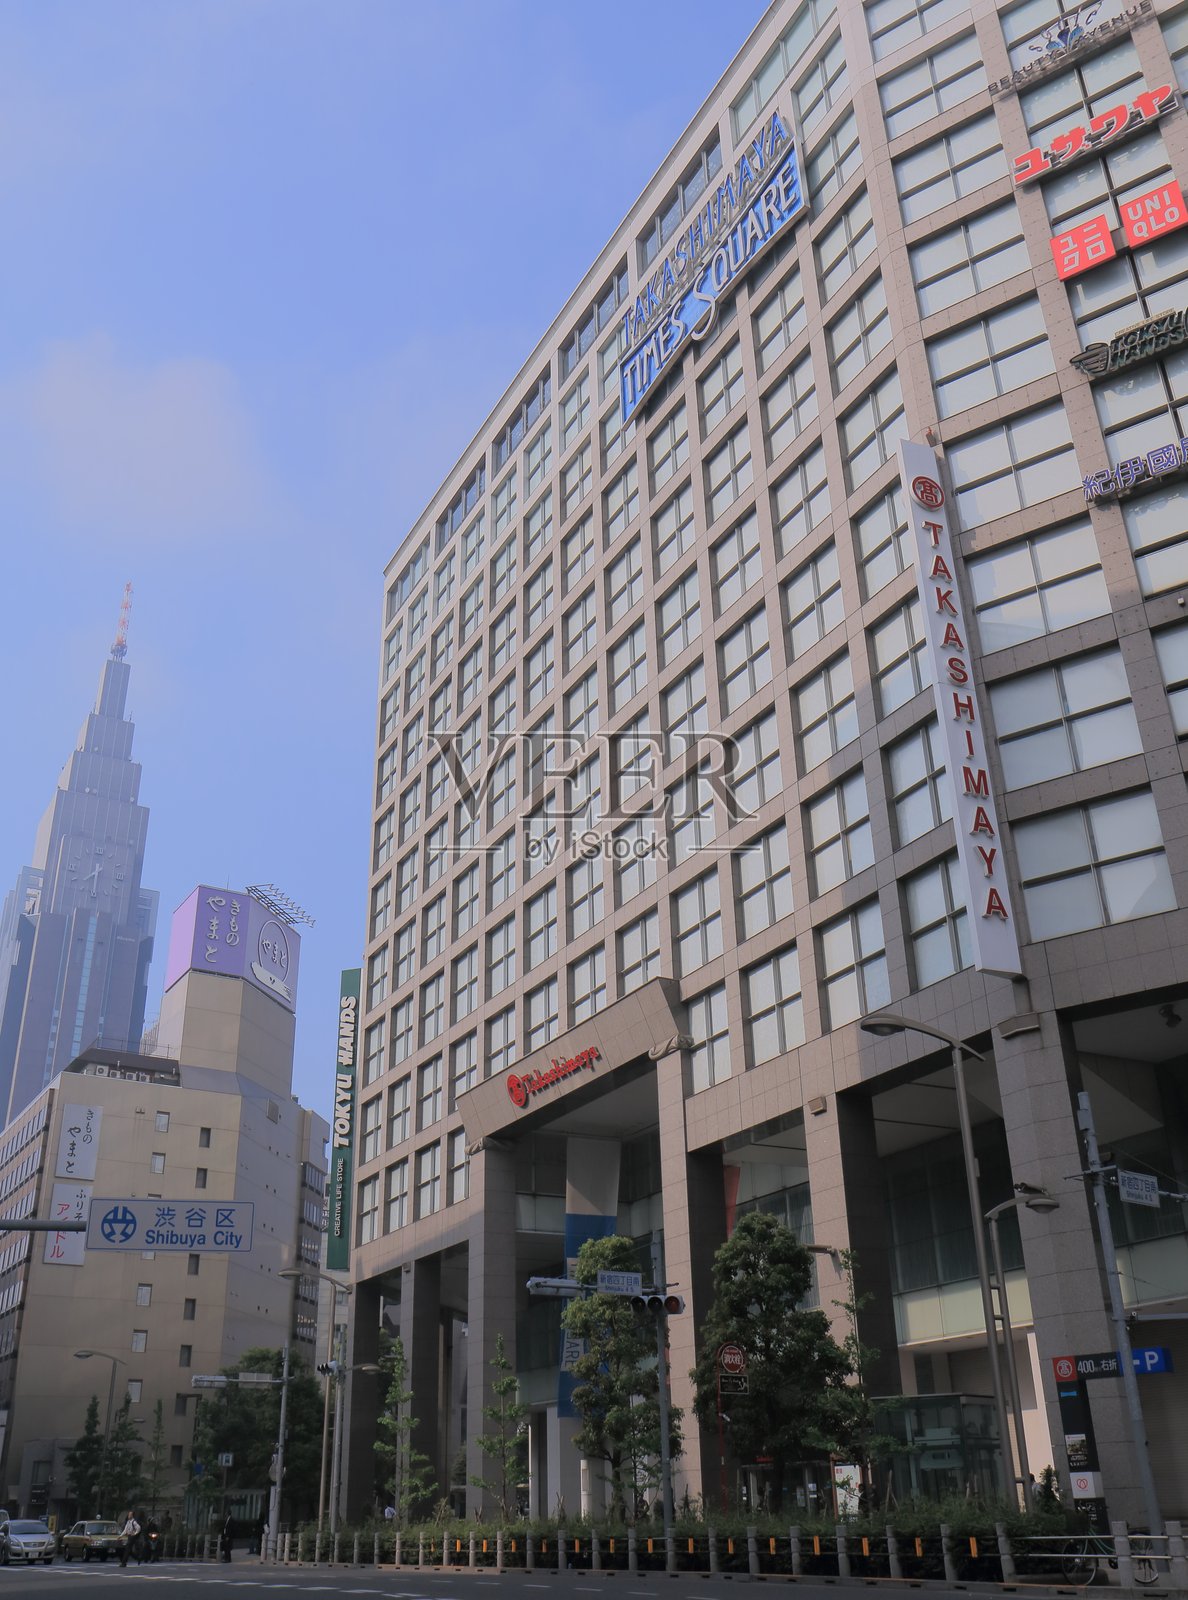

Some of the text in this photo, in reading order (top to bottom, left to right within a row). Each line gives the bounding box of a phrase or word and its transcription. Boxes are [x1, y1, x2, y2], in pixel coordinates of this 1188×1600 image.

[987, 1, 1153, 92] BEAUTY AVENUE
[1014, 85, 1172, 184] ユザワヤ
[622, 110, 789, 344] TAKASHIMAYA
[1127, 190, 1171, 221] UNI
[1132, 206, 1180, 238] QLO
[1060, 223, 1102, 254] ユニ
[1063, 240, 1106, 273] クロ
[623, 161, 798, 404] TIMES SQUARE
[1110, 311, 1184, 352] TOKYU
[1082, 437, 1188, 501] 紀伊國
[921, 520, 1009, 921] TAKASHIMAYA
[205, 895, 226, 963] やまと
[226, 899, 241, 946] きもの
[333, 995, 357, 1148] TOKYU HANDS
[521, 1046, 600, 1094] Takashimaya
[65, 1125, 82, 1174] やまと
[82, 1109, 95, 1145] きもの
[336, 1157, 344, 1182] STORE
[49, 1203, 71, 1259] アドル
[74, 1189, 87, 1235] ふりそ
[154, 1206, 236, 1228] 渋谷区
[334, 1201, 342, 1237] CREATIVE
[145, 1229, 243, 1248] Shibuya City
[1077, 1359, 1095, 1374] 400
[1144, 1351, 1159, 1371] P
